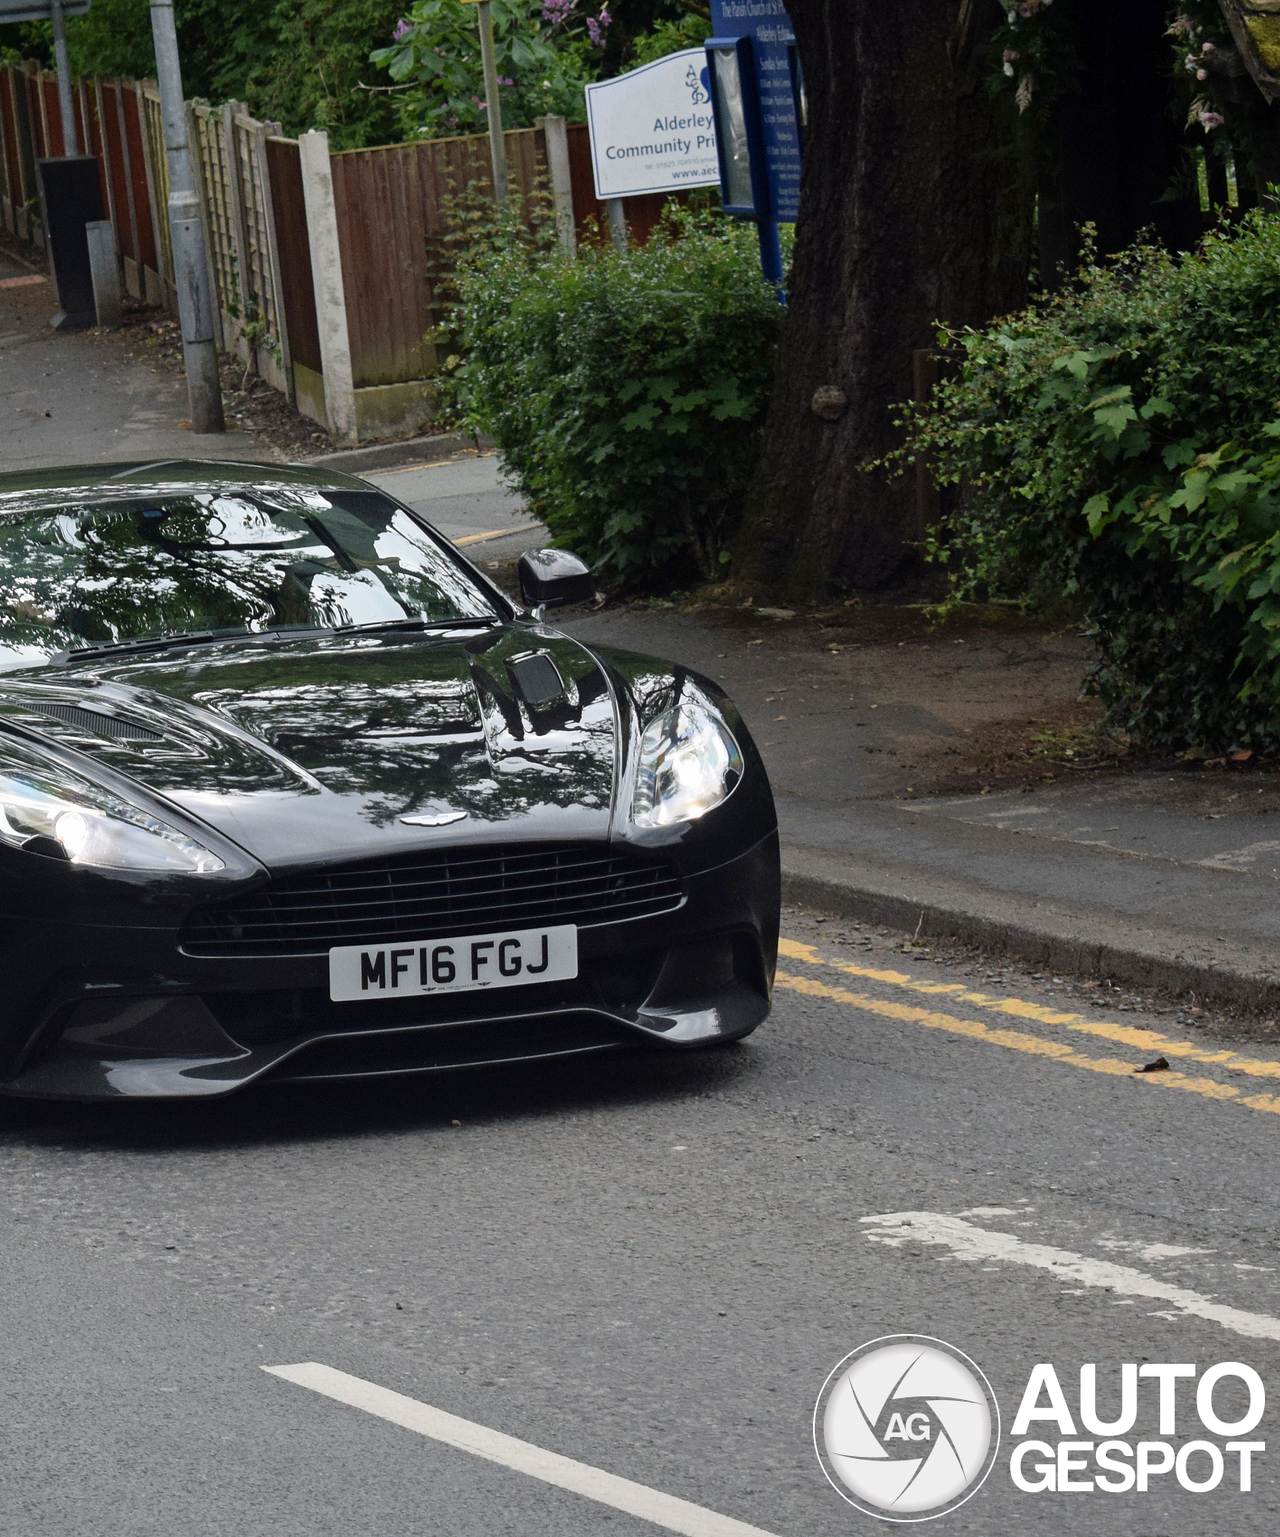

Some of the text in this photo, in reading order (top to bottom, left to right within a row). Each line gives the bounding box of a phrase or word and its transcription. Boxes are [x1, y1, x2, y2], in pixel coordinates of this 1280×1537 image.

[653, 113, 714, 132] Alderley
[606, 133, 715, 160] Community Pri
[360, 934, 548, 990] MF16 FGJ
